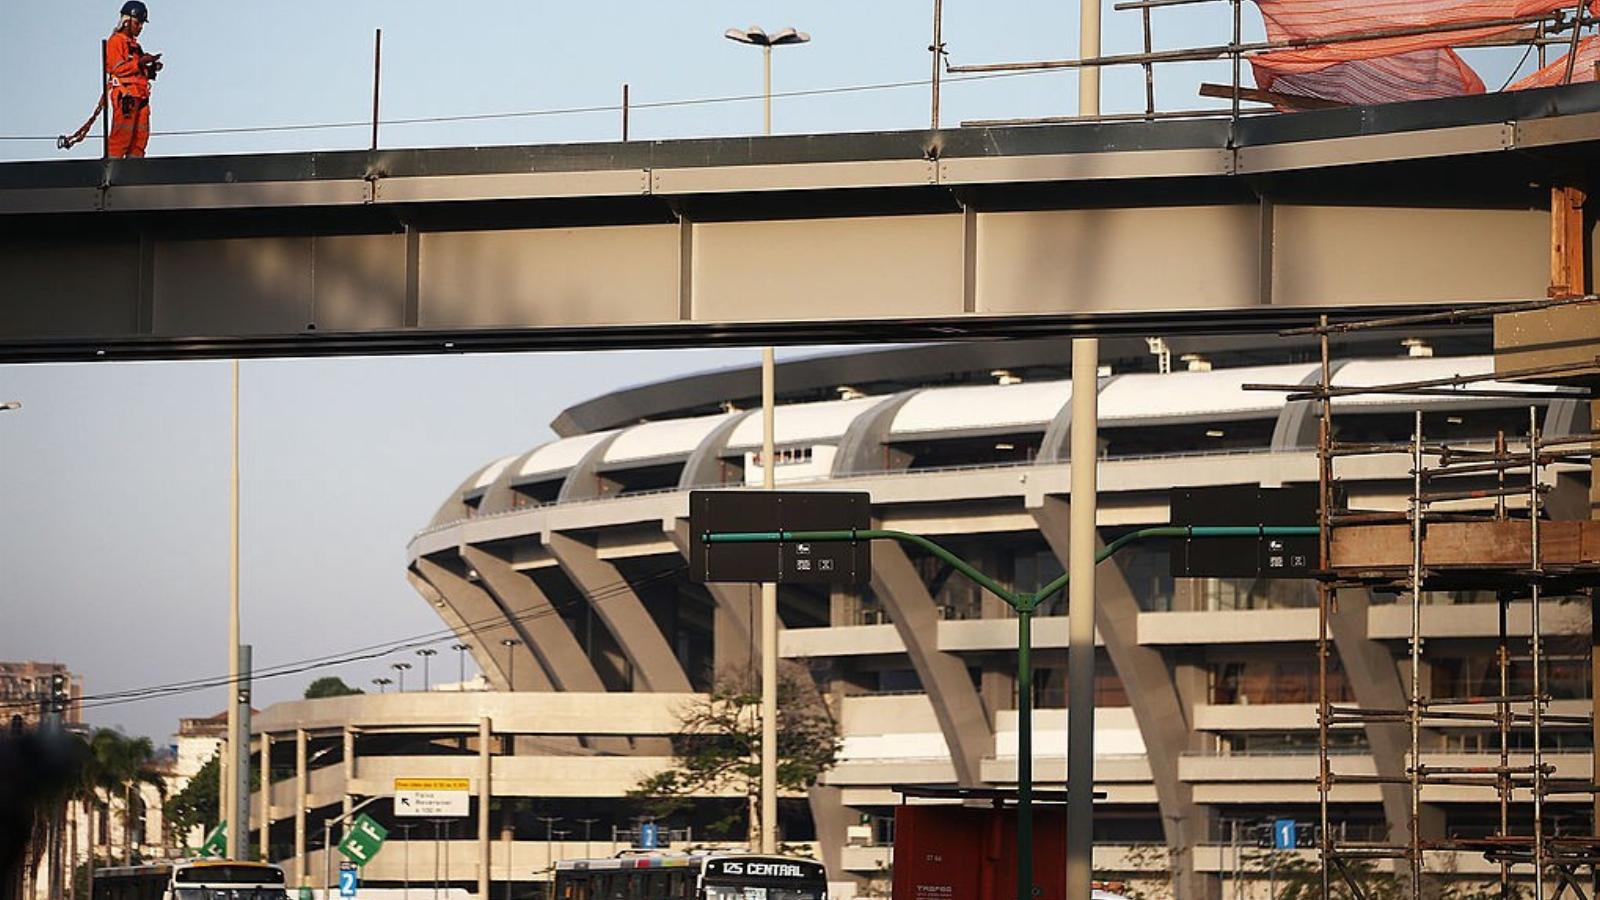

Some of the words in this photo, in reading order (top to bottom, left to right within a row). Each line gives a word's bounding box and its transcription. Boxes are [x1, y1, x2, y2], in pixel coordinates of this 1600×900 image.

[1281, 826, 1289, 847] 1
[723, 863, 744, 875] 125
[746, 863, 804, 877] CENTRAL
[341, 873, 354, 895] 2
